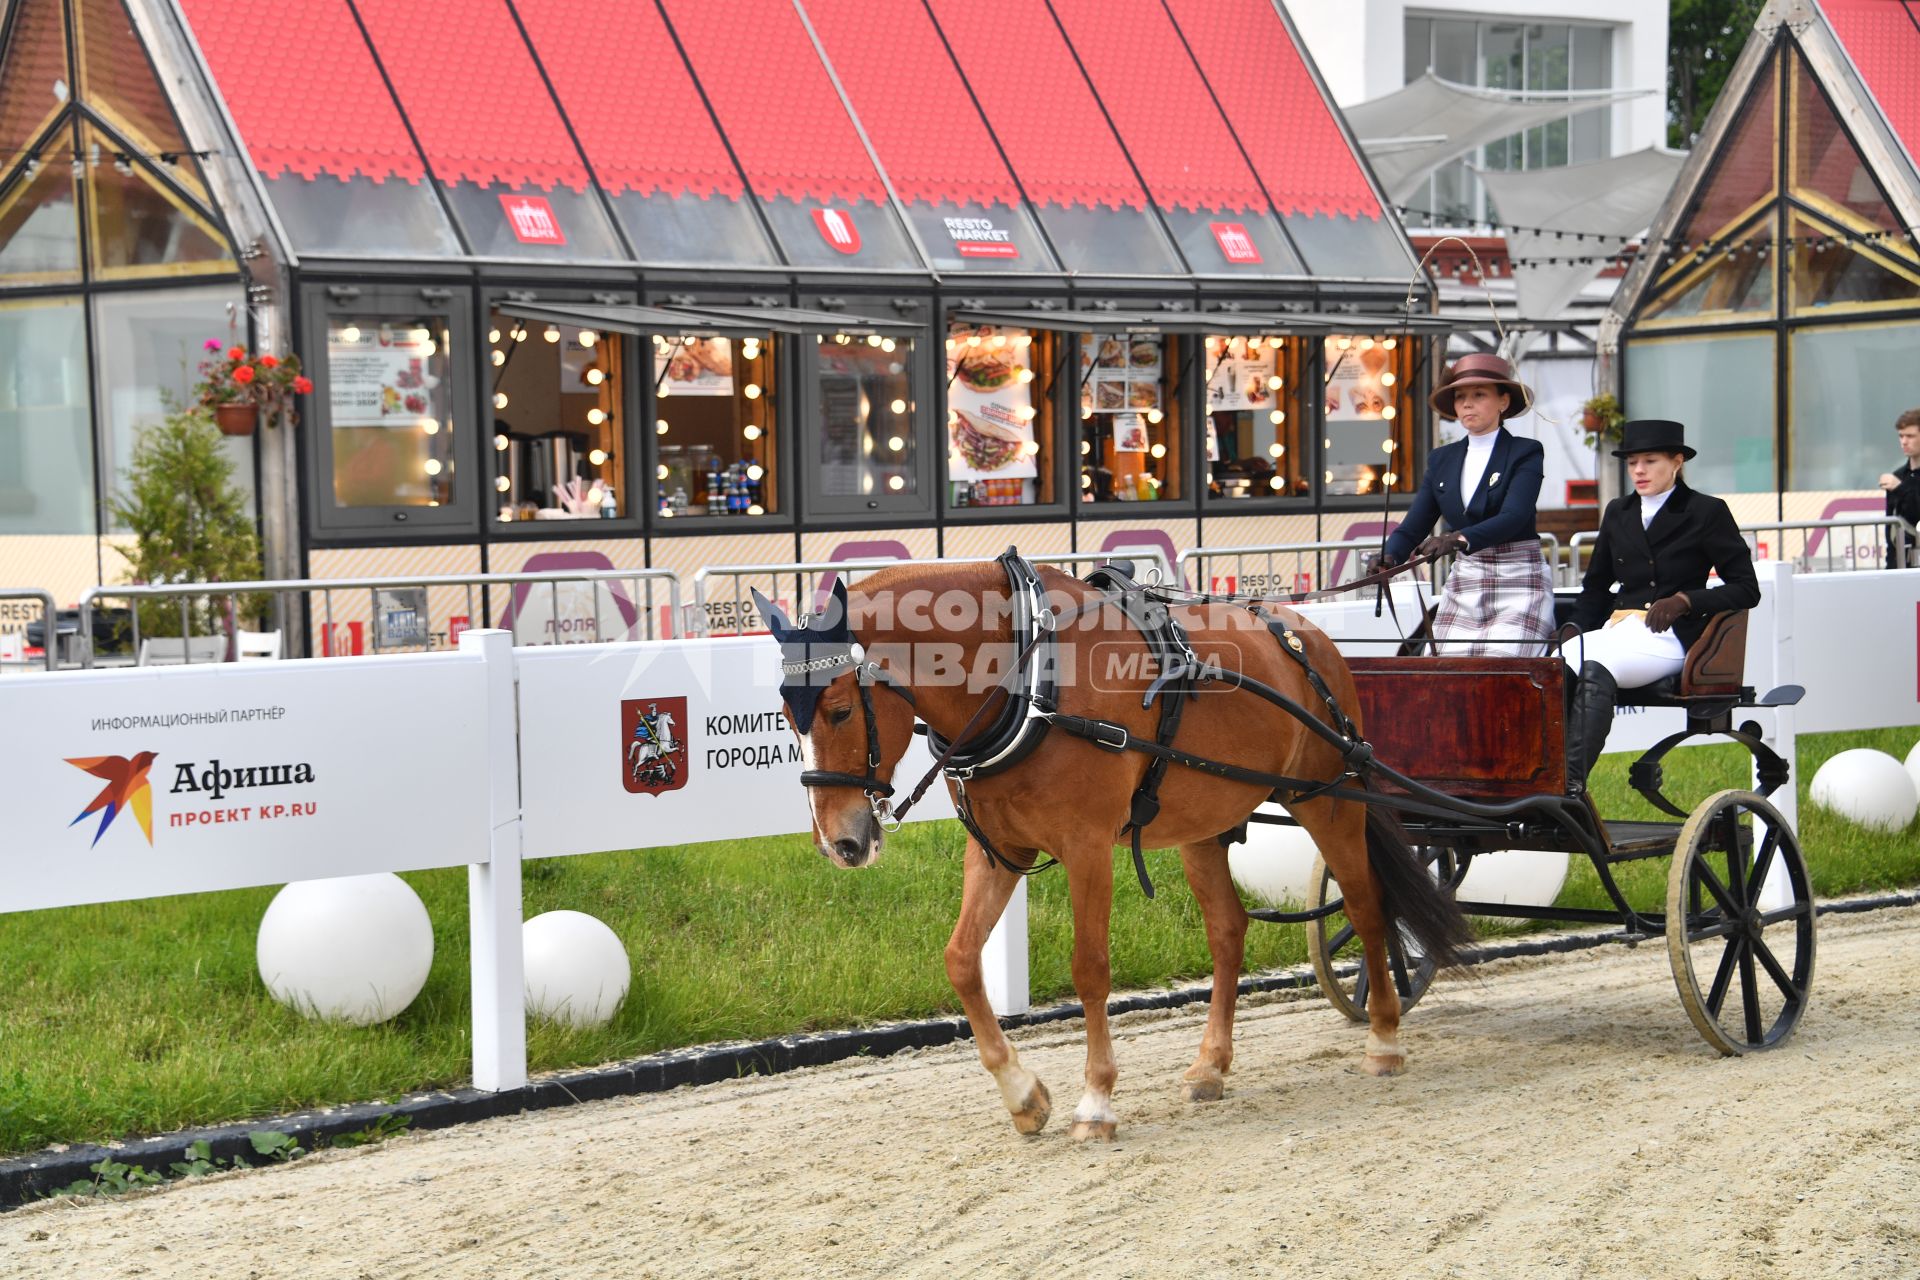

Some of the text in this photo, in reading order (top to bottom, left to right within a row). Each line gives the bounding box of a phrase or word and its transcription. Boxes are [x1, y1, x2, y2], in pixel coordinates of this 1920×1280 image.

[943, 217, 993, 230] RESTO
[949, 229, 1009, 241] MARKET
[1, 603, 44, 620] REST
[545, 618, 595, 633] ЛЮЛЯ
[92, 707, 286, 731] ИНФОРМАЦИОННЫЙ ПАРТНЁР
[706, 711, 793, 736] КОМИТЕ
[706, 744, 784, 770] ГОРОДА
[169, 759, 316, 800] Афиша
[169, 802, 317, 827] ПРОЕКТ KP.RU
